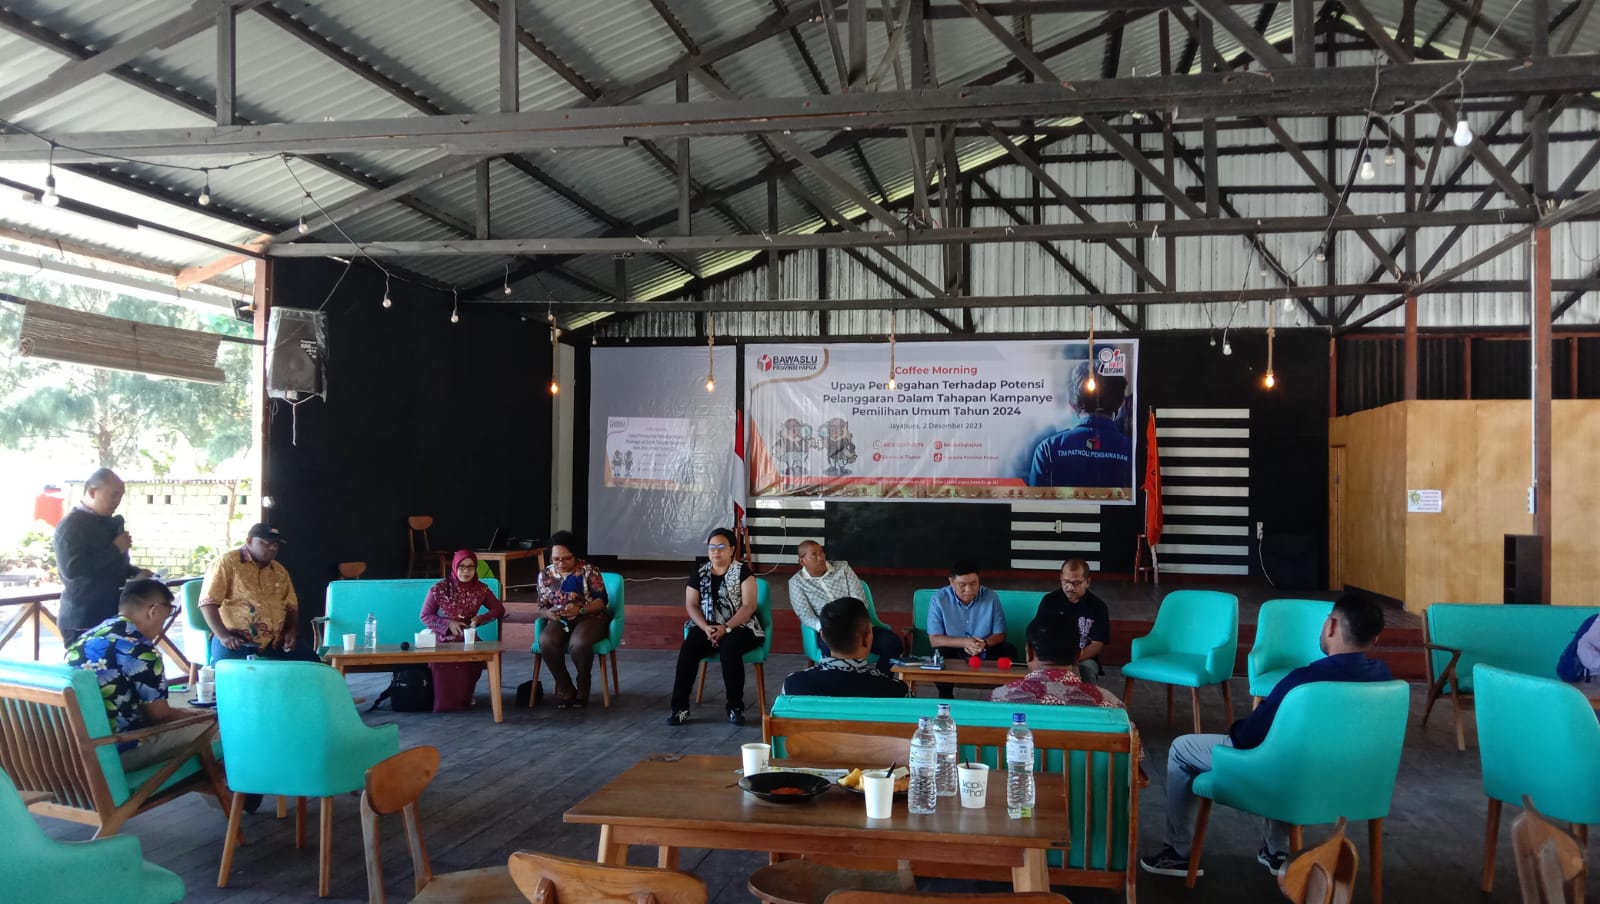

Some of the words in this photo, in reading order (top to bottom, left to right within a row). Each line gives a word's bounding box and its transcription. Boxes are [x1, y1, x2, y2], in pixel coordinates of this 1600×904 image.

[773, 355, 818, 364] BAWASLU
[894, 366, 930, 375] Coffee
[932, 365, 978, 376] Morning
[831, 381, 866, 392] Upaya
[868, 380, 939, 392] Penegahan
[942, 380, 997, 391] Terhadap
[1000, 379, 1045, 389] Potensi
[823, 394, 894, 405] Pelanggaran
[897, 394, 934, 403] Dalam
[937, 394, 985, 404] Tahapan
[990, 393, 1053, 404] Kampanye
[852, 407, 909, 416] Pemilihan
[911, 407, 950, 416] Umum
[953, 407, 990, 416] Tahun
[992, 407, 1022, 416] 2024
[1090, 451, 1128, 461] PENGAWASAN
